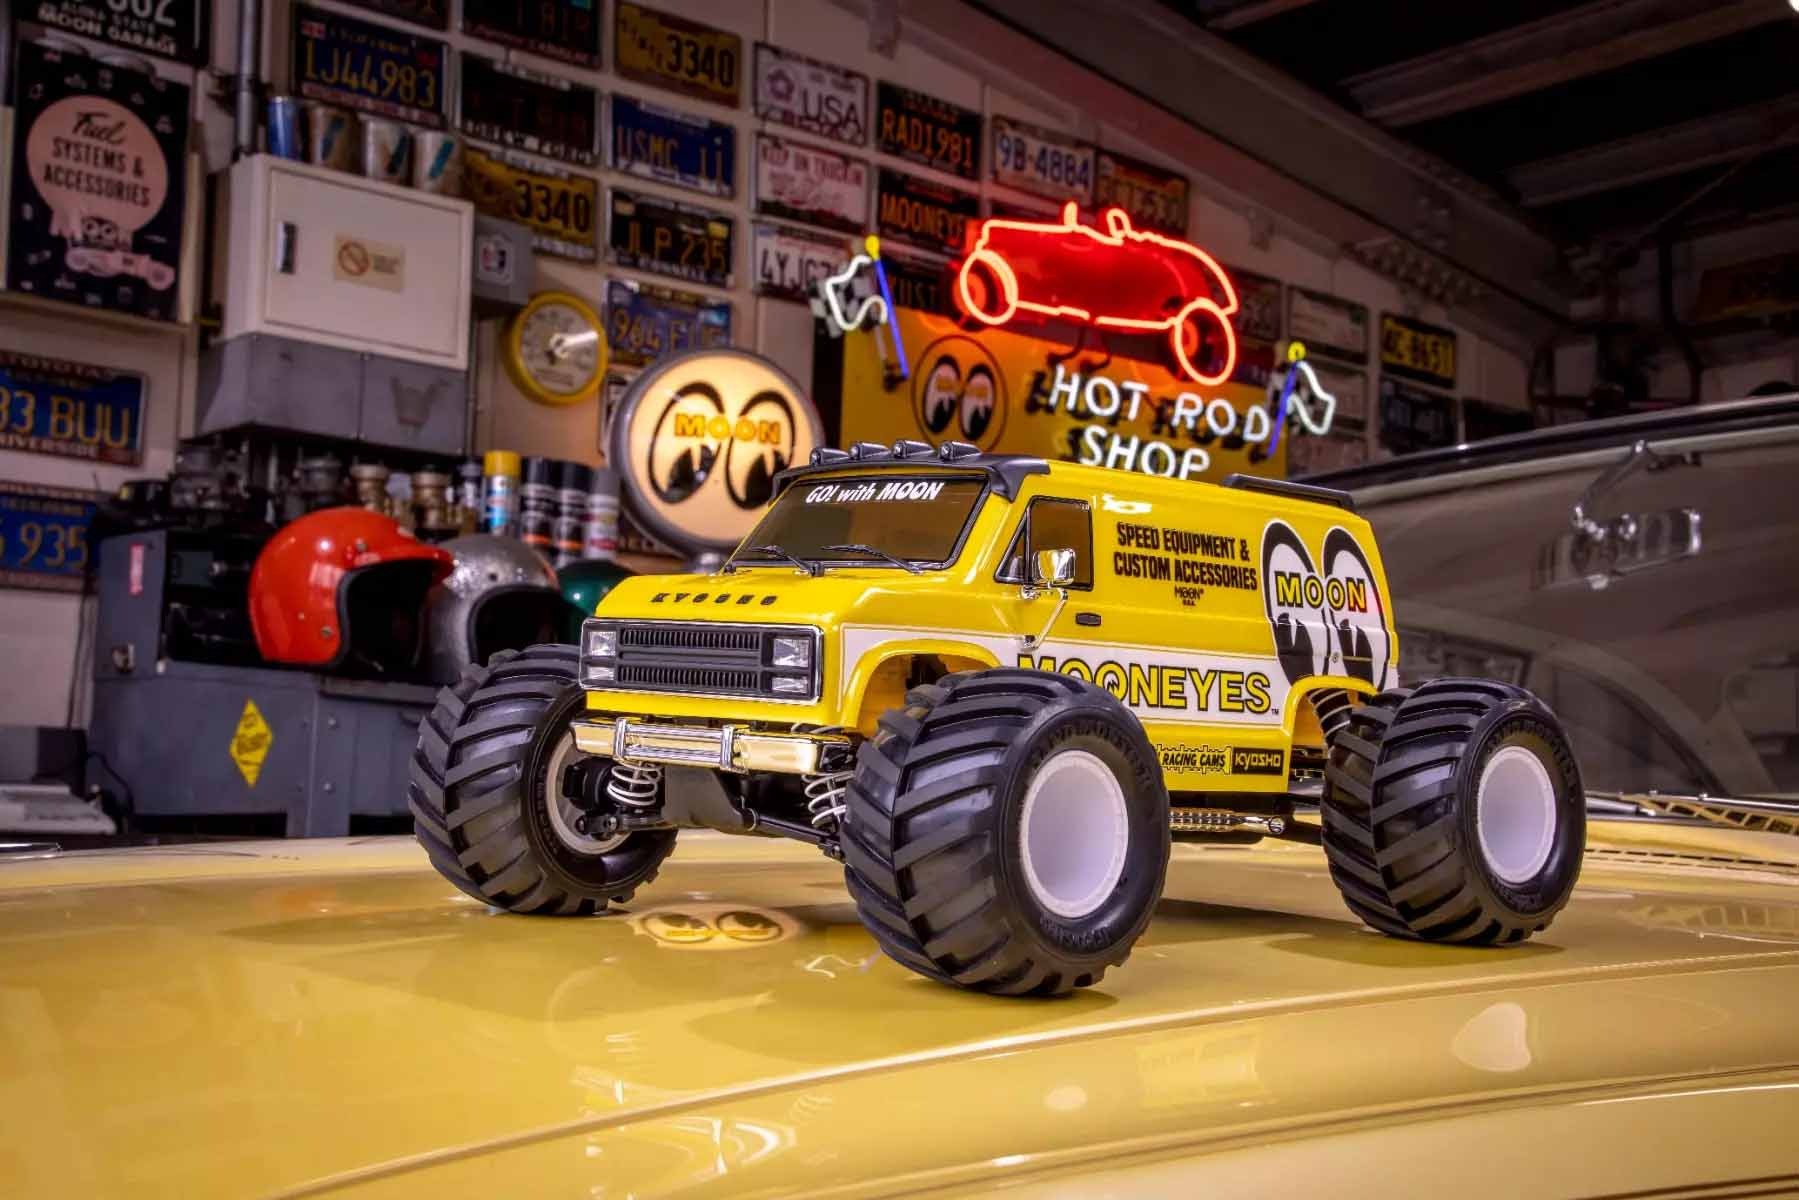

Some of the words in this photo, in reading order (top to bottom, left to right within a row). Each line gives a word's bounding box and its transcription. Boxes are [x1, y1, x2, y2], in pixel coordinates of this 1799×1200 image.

[37, 3, 102, 36] MOON
[106, 25, 177, 55] GARAGE
[664, 34, 735, 87] 3340
[72, 111, 127, 145] Fuel
[803, 87, 862, 134] USA
[53, 136, 126, 176] SYSTEMS
[133, 156, 144, 178] &
[43, 164, 150, 208] ACCESSORIES
[513, 179, 589, 232] 3340
[51, 394, 130, 448] BUU
[1049, 364, 1149, 422] HOT
[1171, 391, 1270, 442] ROD
[674, 412, 781, 445] MOON
[1079, 424, 1210, 481] SHOP
[806, 485, 840, 503] GO!
[837, 482, 876, 502] with
[876, 481, 944, 500] MOON
[20, 520, 88, 568] 935
[1116, 521, 1160, 549] SPEED
[1162, 527, 1236, 560] EQUIPMENT
[1239, 538, 1250, 562] &
[1113, 551, 1171, 581] CUSTOM
[1173, 558, 1258, 590] ACCESSORIES
[1274, 570, 1368, 614] MOON
[650, 592, 778, 606] KYOSHO
[1162, 752, 1197, 767] RACING
[1199, 753, 1226, 768] CAMS
[1235, 752, 1281, 771] KYOSHO
